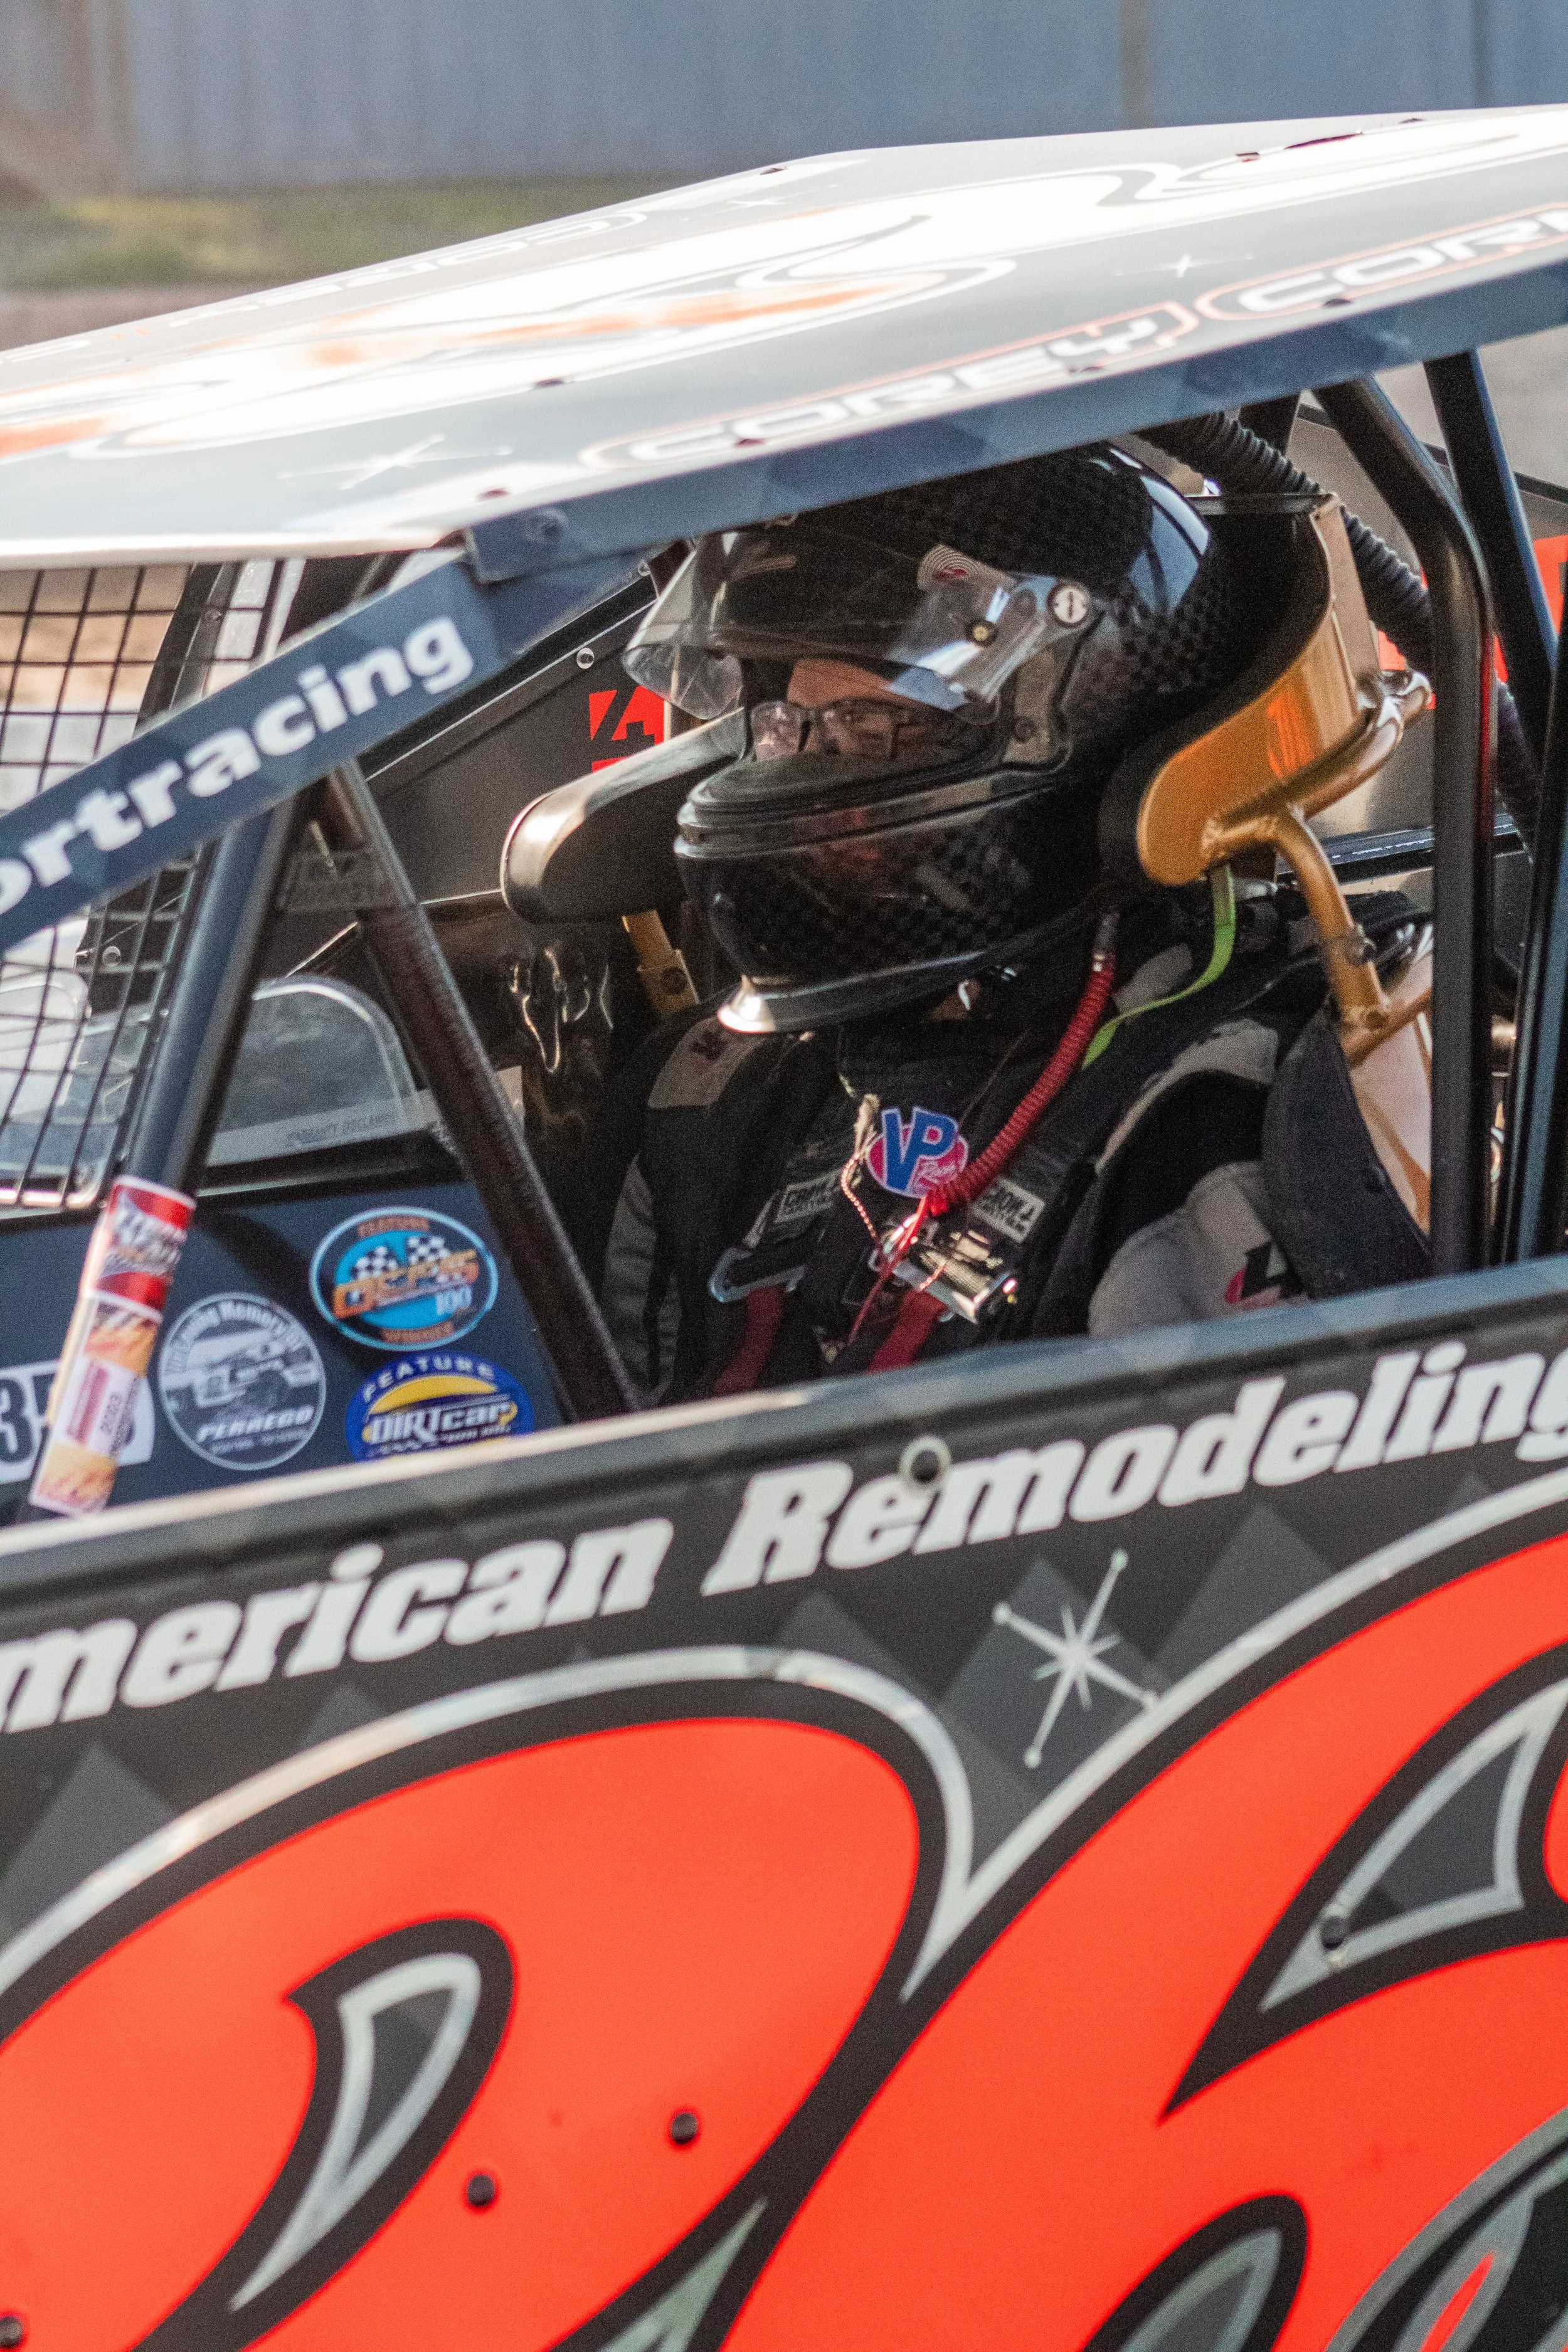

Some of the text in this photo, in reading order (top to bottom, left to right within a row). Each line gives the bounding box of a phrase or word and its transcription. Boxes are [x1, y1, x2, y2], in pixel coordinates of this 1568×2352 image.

[881, 1106, 960, 1193] VP
[435, 1286, 473, 1315] 100
[363, 1355, 494, 1403] FEATURE
[702, 1341, 1568, 1596] Remodeling
